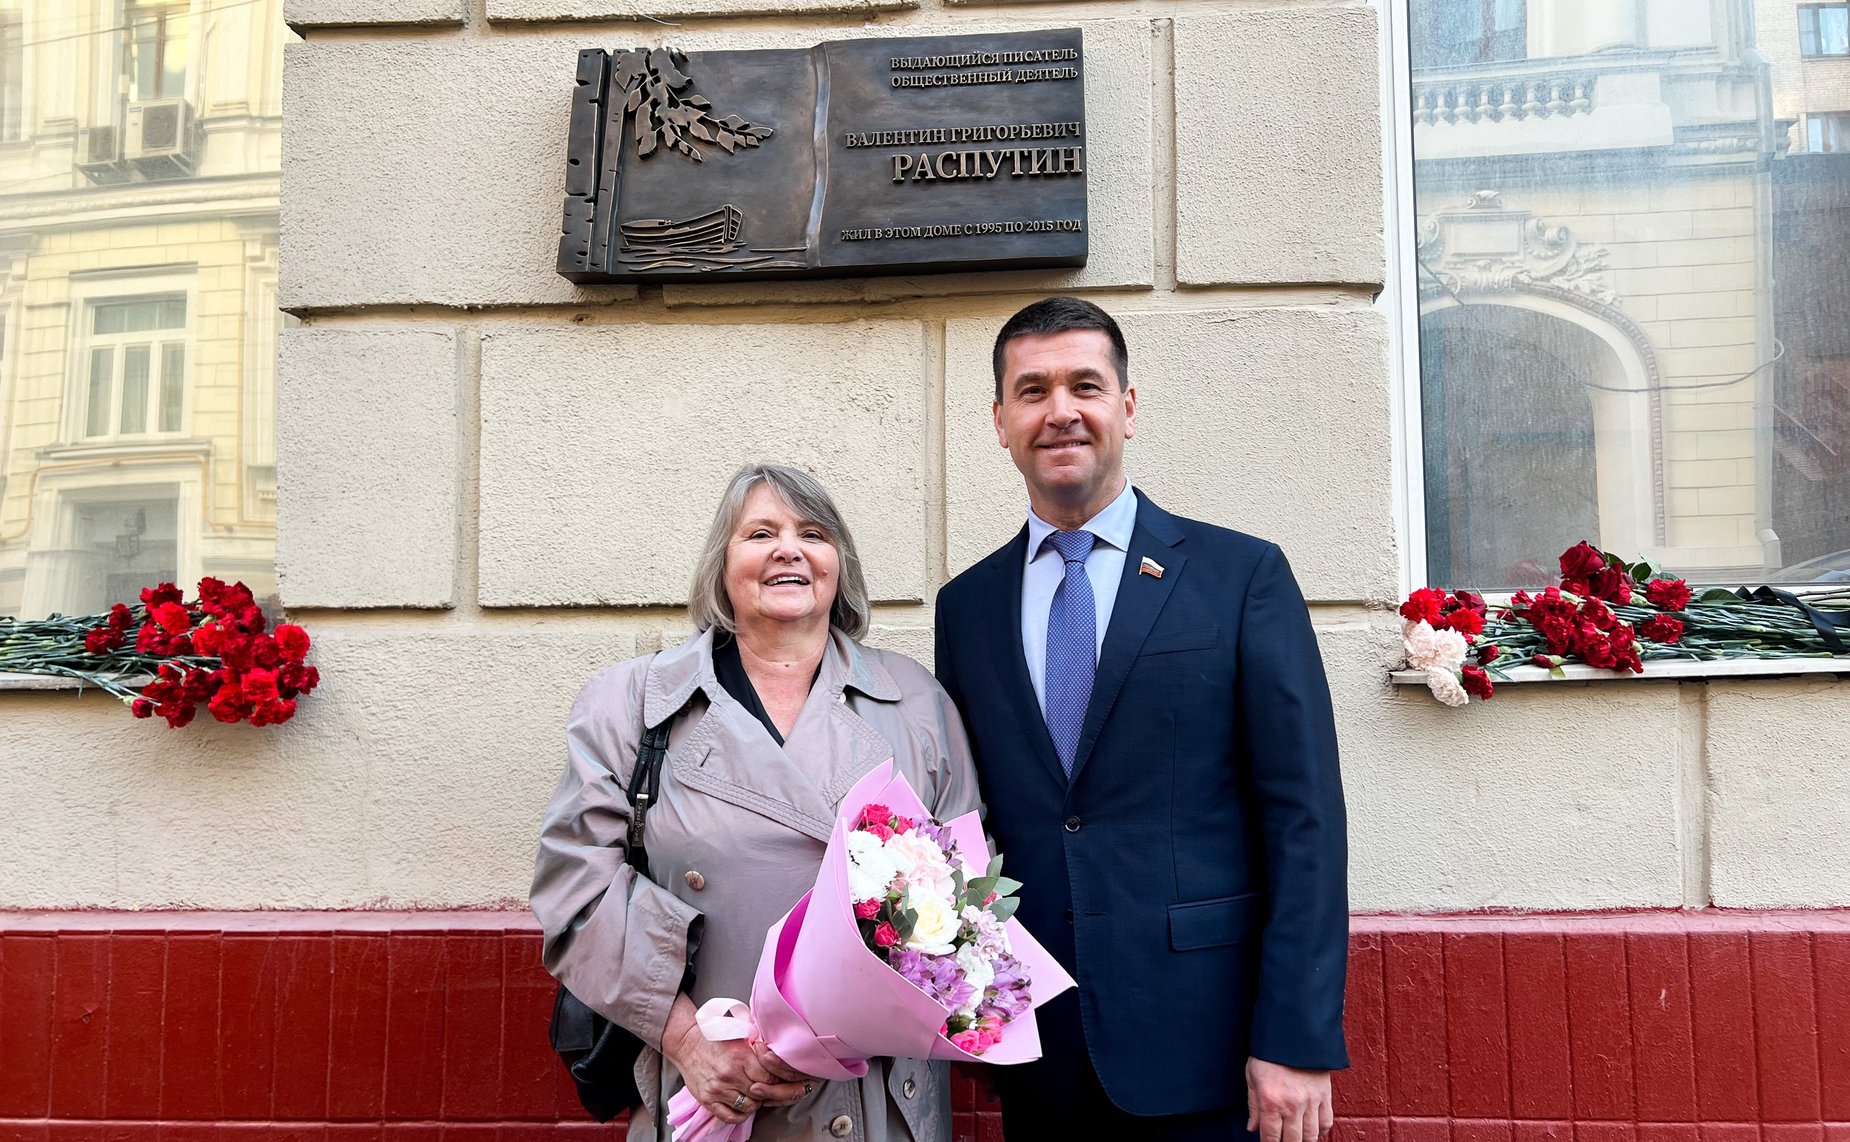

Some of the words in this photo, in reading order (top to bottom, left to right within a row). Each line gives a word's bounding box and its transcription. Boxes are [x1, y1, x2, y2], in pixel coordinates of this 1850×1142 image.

[890, 51, 1000, 69] ВЫДАЮЩИЙСЯ
[1003, 48, 1079, 63] ПИСАТЕЛЬ
[891, 68, 1013, 87] ОБЩЕСТВЕННЫЙ
[1016, 67, 1079, 83] ДЕЯТЕЛЬ
[846, 128, 947, 148] ВАЛЕНТИН
[950, 121, 1081, 143] ГРИГОРЬЕВИЧ
[892, 146, 1083, 182] РАСПУТИН
[841, 229, 872, 241] ЖИЛ
[874, 228, 883, 239] В
[885, 226, 922, 239] ЭТОМ
[923, 225, 961, 238] ДОМЕ
[964, 225, 973, 235] С
[975, 223, 1002, 235] 1995
[1005, 221, 1024, 233] ПО
[1026, 220, 1054, 232] 2015
[1056, 219, 1082, 232] ГОД
